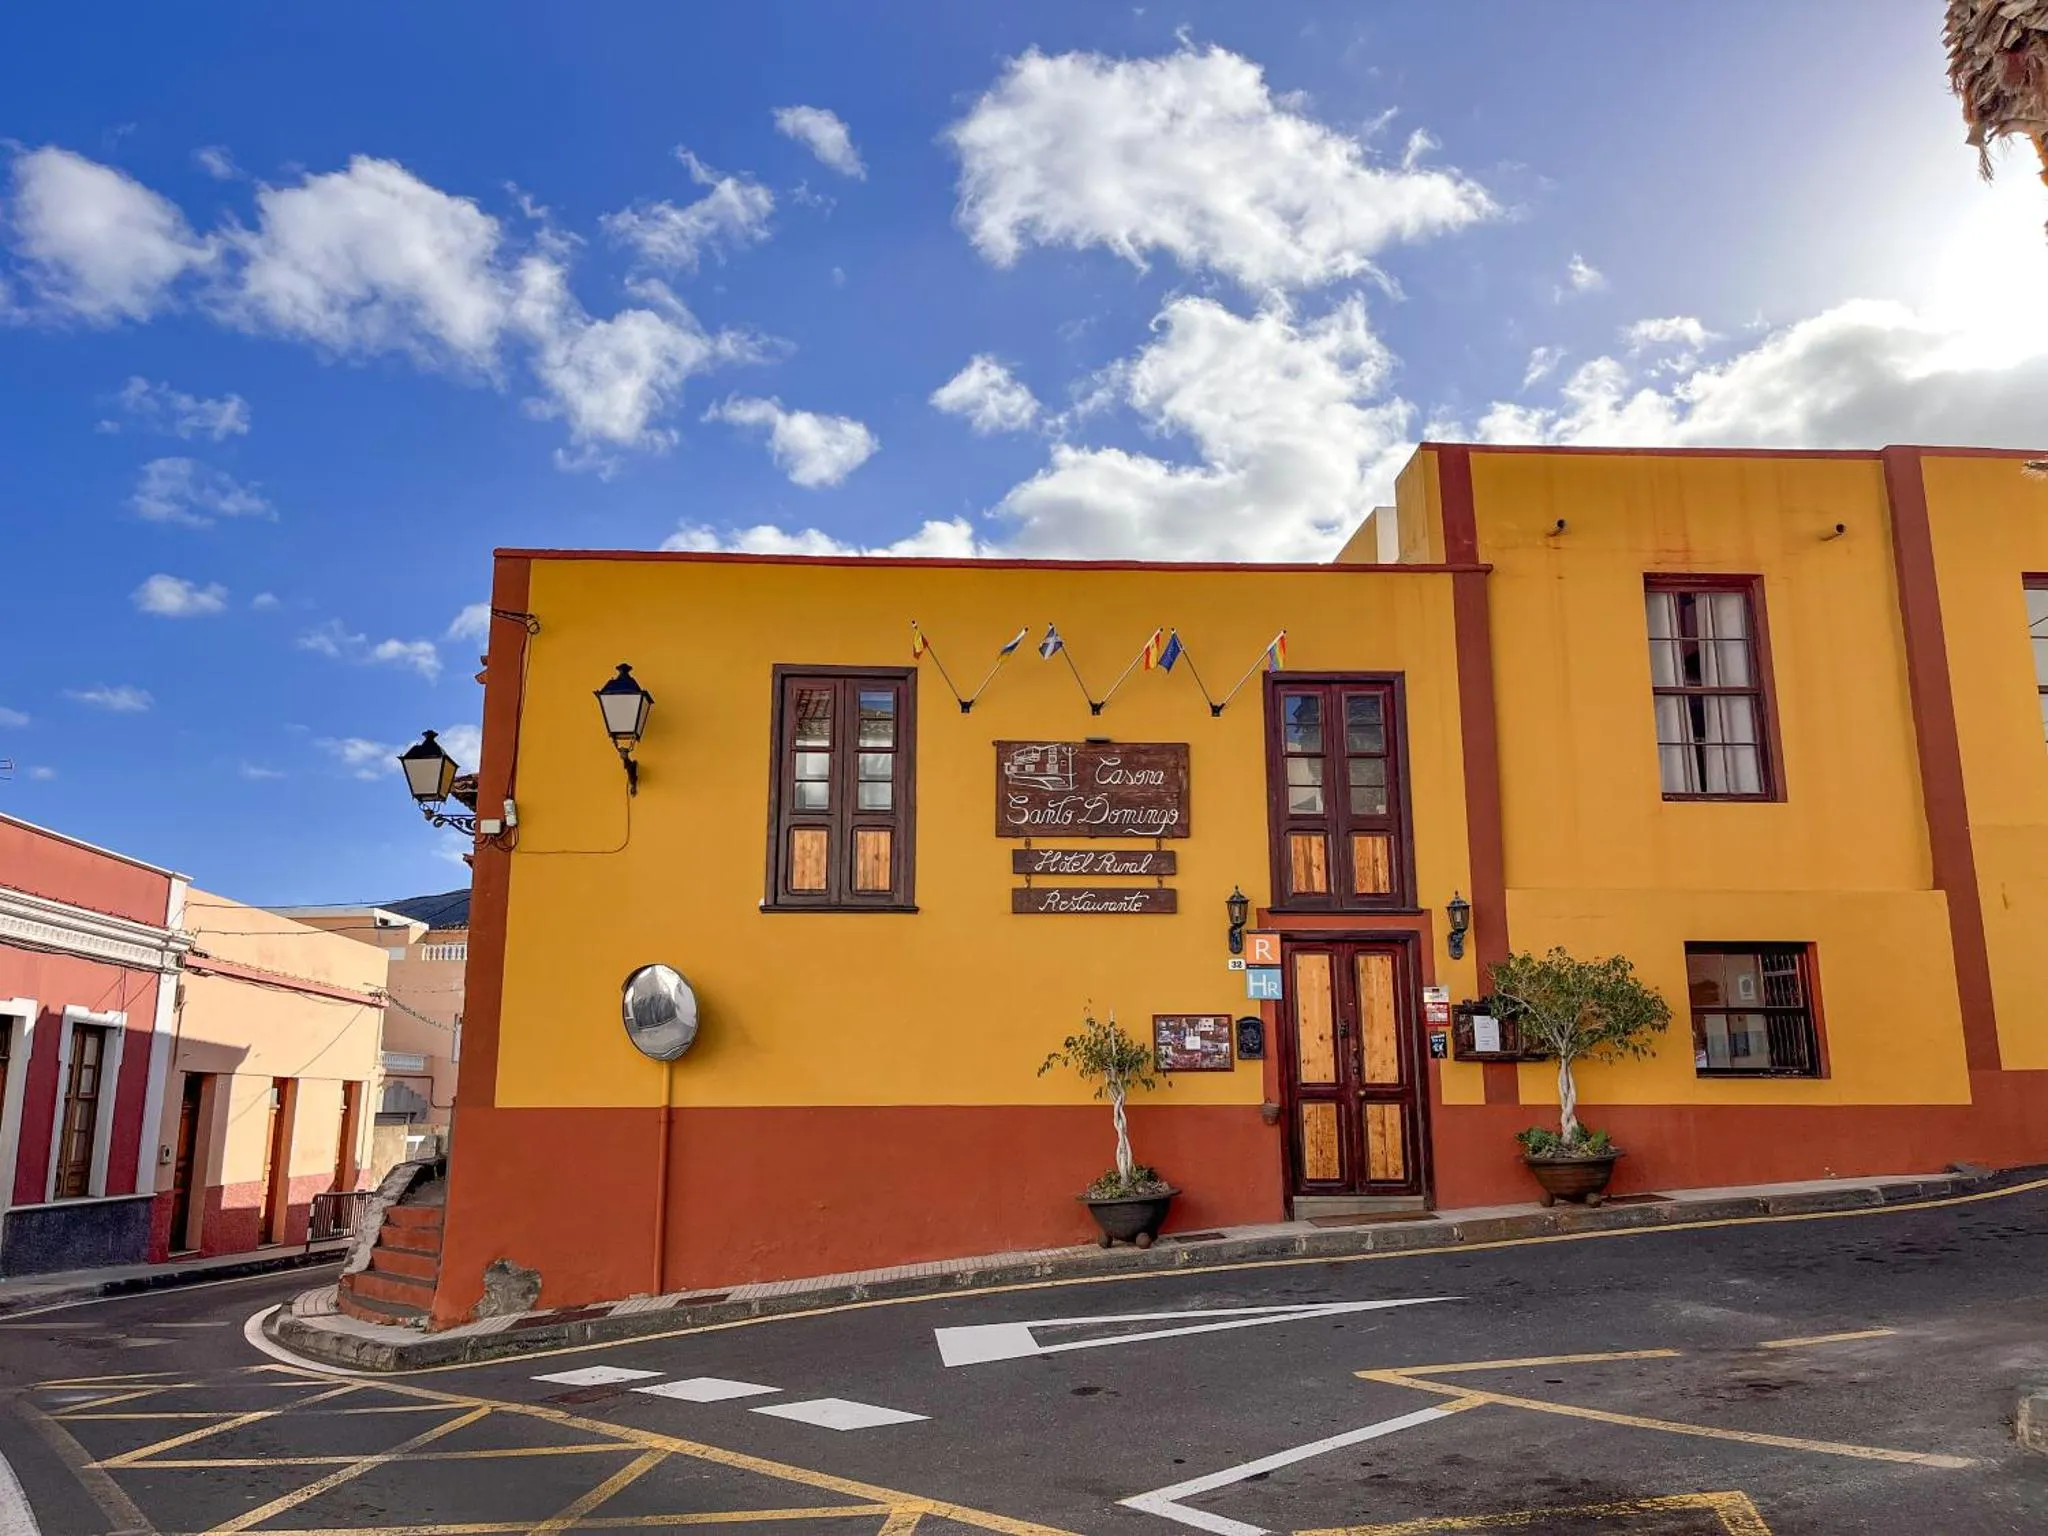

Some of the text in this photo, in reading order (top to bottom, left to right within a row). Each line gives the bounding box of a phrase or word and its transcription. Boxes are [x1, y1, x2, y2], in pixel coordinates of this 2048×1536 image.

[1095, 757, 1165, 786] Casona
[1007, 793, 1178, 835] Santo Domingo
[1034, 850, 1153, 873] Hotel Rural
[1038, 889, 1149, 912] Restaurante
[1255, 938, 1273, 960] R
[1231, 960, 1242, 969] 32
[1248, 973, 1279, 996] HR
